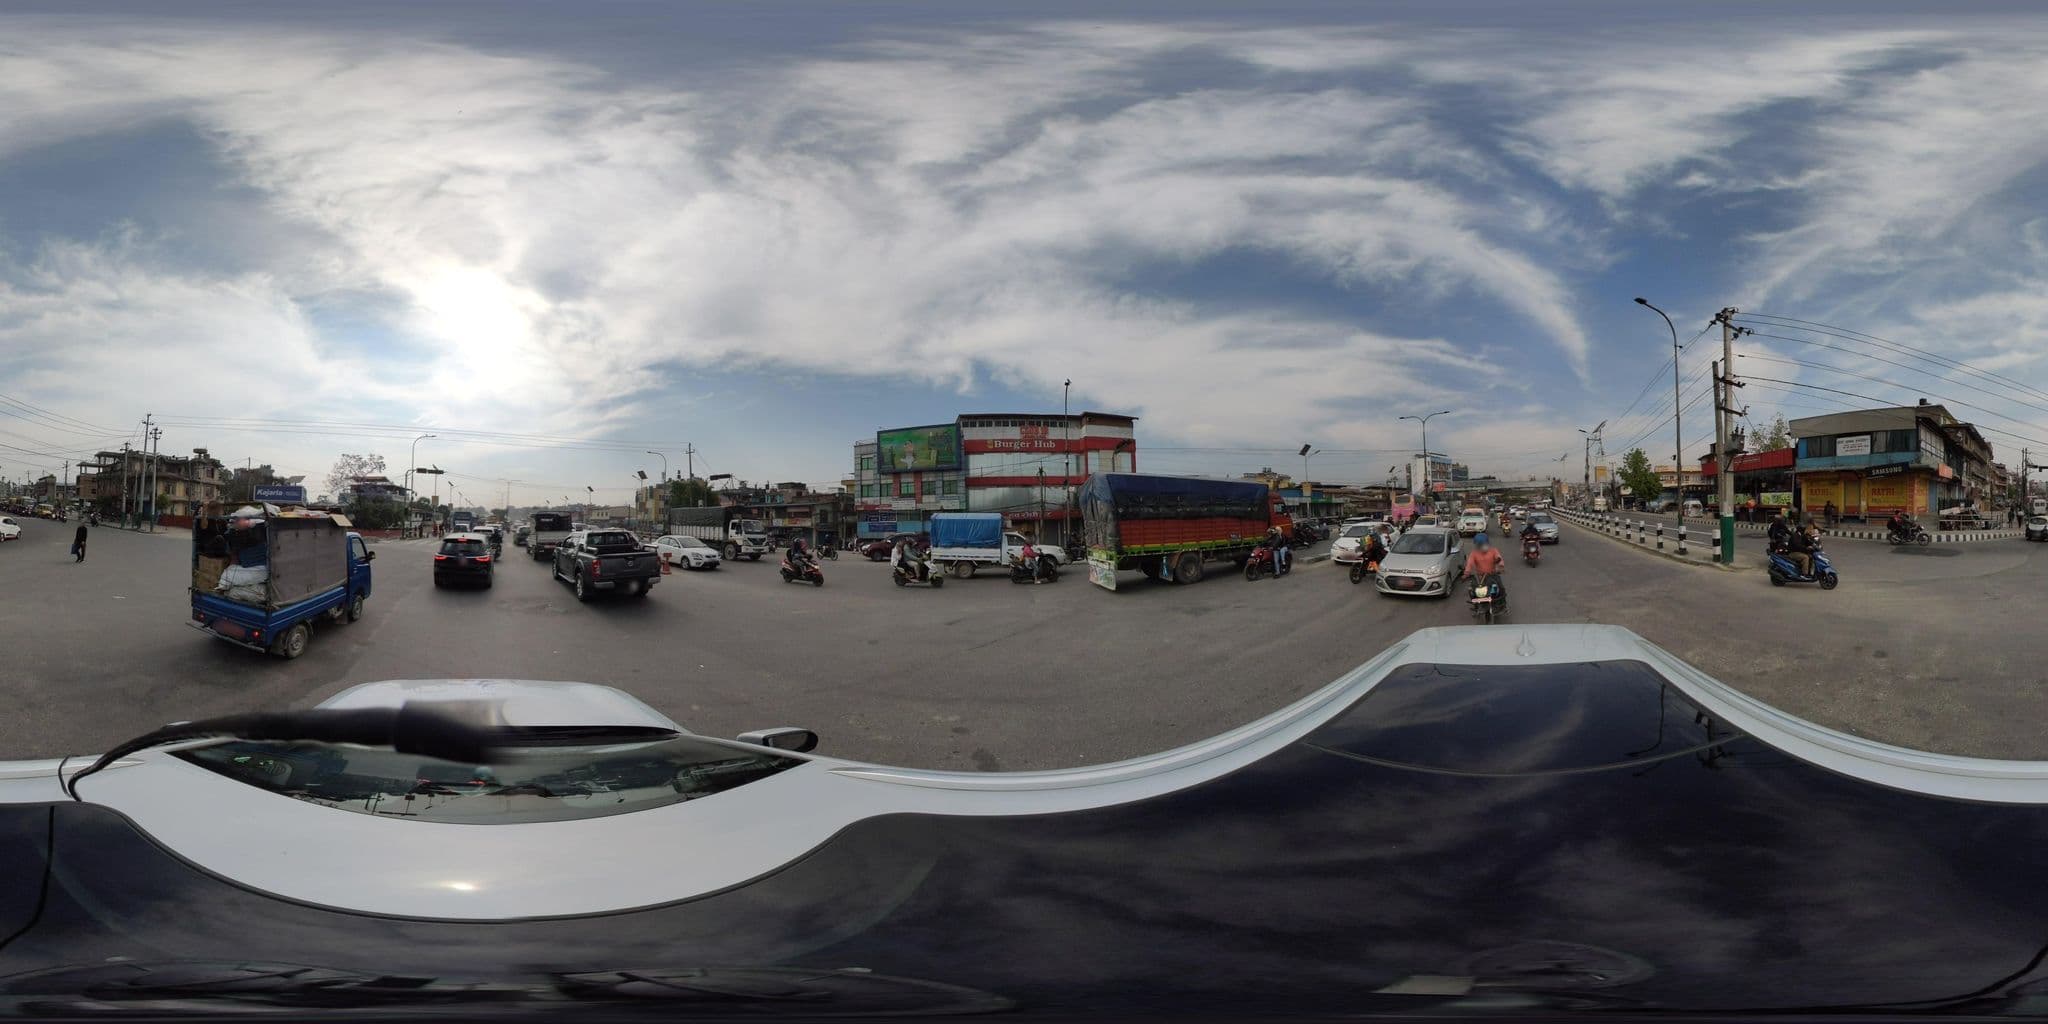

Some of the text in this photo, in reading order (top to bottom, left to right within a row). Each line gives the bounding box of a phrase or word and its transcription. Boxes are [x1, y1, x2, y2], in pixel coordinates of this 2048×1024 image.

[994, 440, 1056, 449] Burger Hub
[1871, 466, 1902, 475] SAMSUNG
[257, 489, 283, 497] Kajaria
